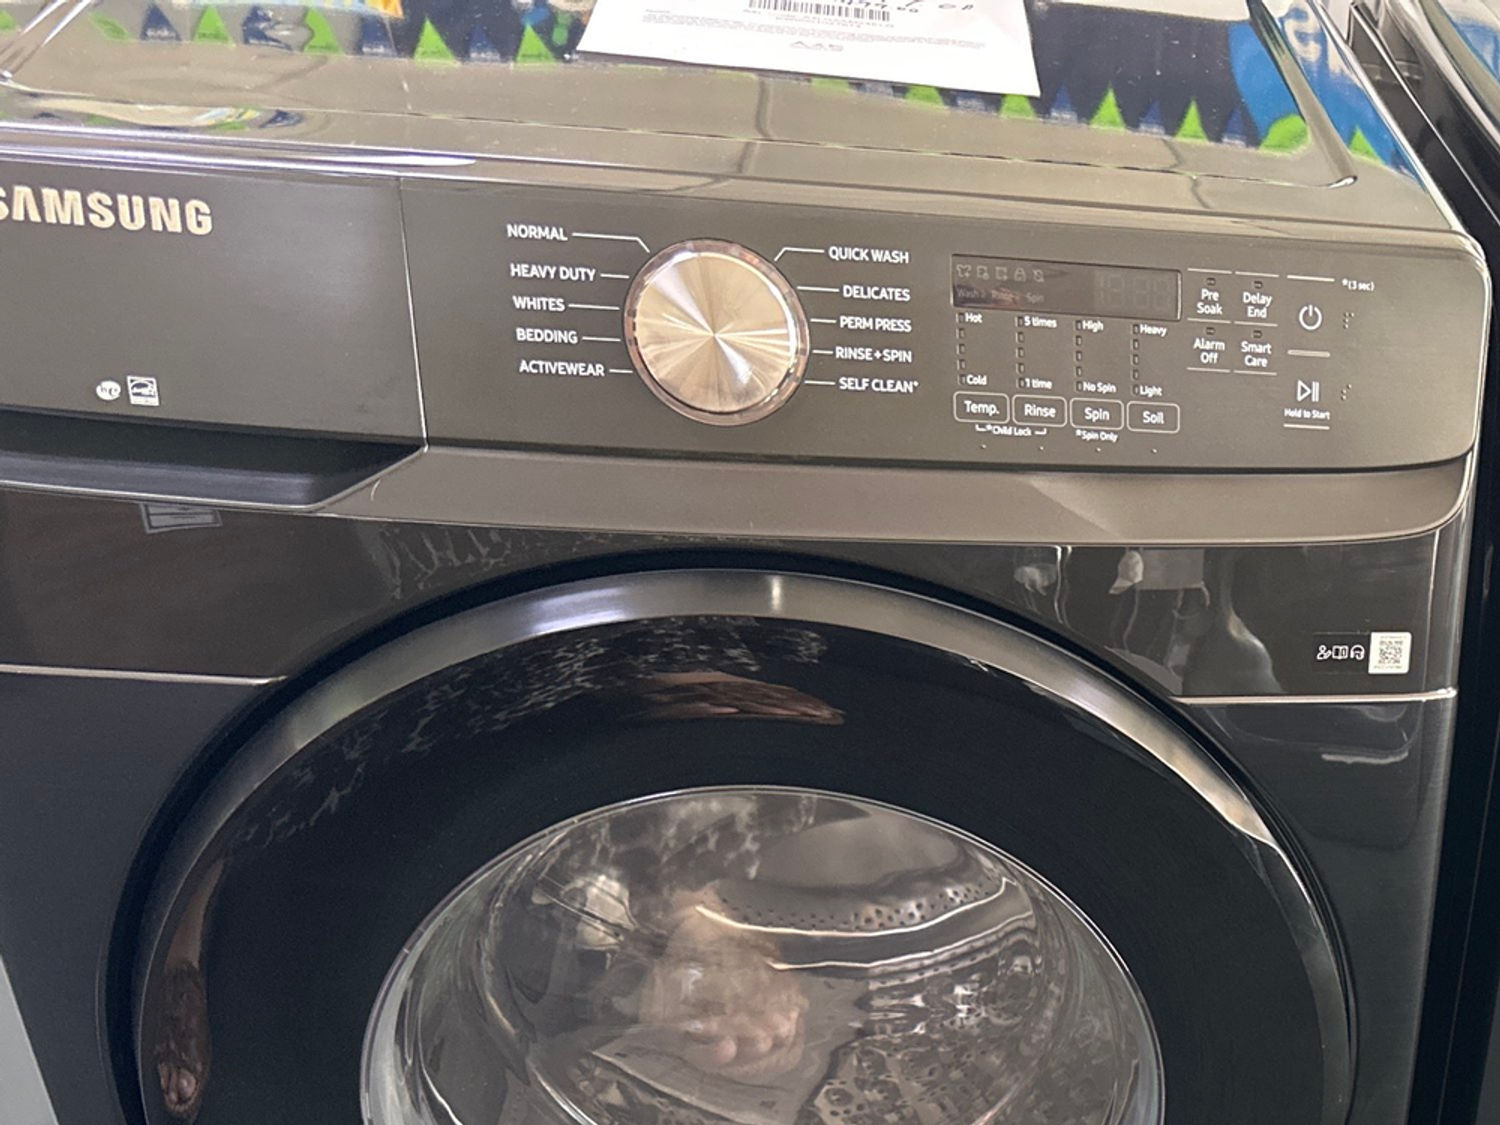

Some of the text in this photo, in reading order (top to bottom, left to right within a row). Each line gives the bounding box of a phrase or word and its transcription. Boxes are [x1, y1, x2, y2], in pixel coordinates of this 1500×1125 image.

[506, 223, 568, 241] NORMAL
[828, 246, 909, 264] QUICK WASH
[510, 263, 596, 281] HEAVY DUTY
[842, 284, 911, 302] DELICATES
[1201, 289, 1219, 301] Pre
[1243, 292, 1272, 307] Delay
[512, 295, 565, 311] WHITES
[1197, 303, 1222, 315] Soak
[965, 312, 983, 324] Hot
[1247, 306, 1267, 318] End
[839, 315, 912, 332] PERM PRESS
[1032, 318, 1058, 329] times
[1082, 320, 1104, 333] High
[516, 327, 578, 344] BEDDING
[1139, 324, 1168, 337] Heavy
[1193, 338, 1225, 351] Alarm
[1241, 341, 1272, 354] Smart
[835, 346, 873, 361] RINSE
[883, 350, 912, 363] SPIN
[1200, 353, 1218, 364] Off
[519, 359, 605, 377] ACTIVEWEAR
[1244, 355, 1268, 368] Care
[839, 377, 869, 392] SELF
[966, 374, 987, 386] Cold
[1031, 378, 1052, 390] time
[1083, 382, 1117, 395] No Spin
[1139, 386, 1163, 398] Light
[963, 400, 1000, 416] Temp.
[1024, 403, 1057, 418] Rinse
[1084, 407, 1110, 422] Spin
[1284, 408, 1330, 420] Hold to Start
[1142, 411, 1165, 425] Soil
[1014, 426, 1032, 437] Lock
[1081, 431, 1118, 443] Spin Only
